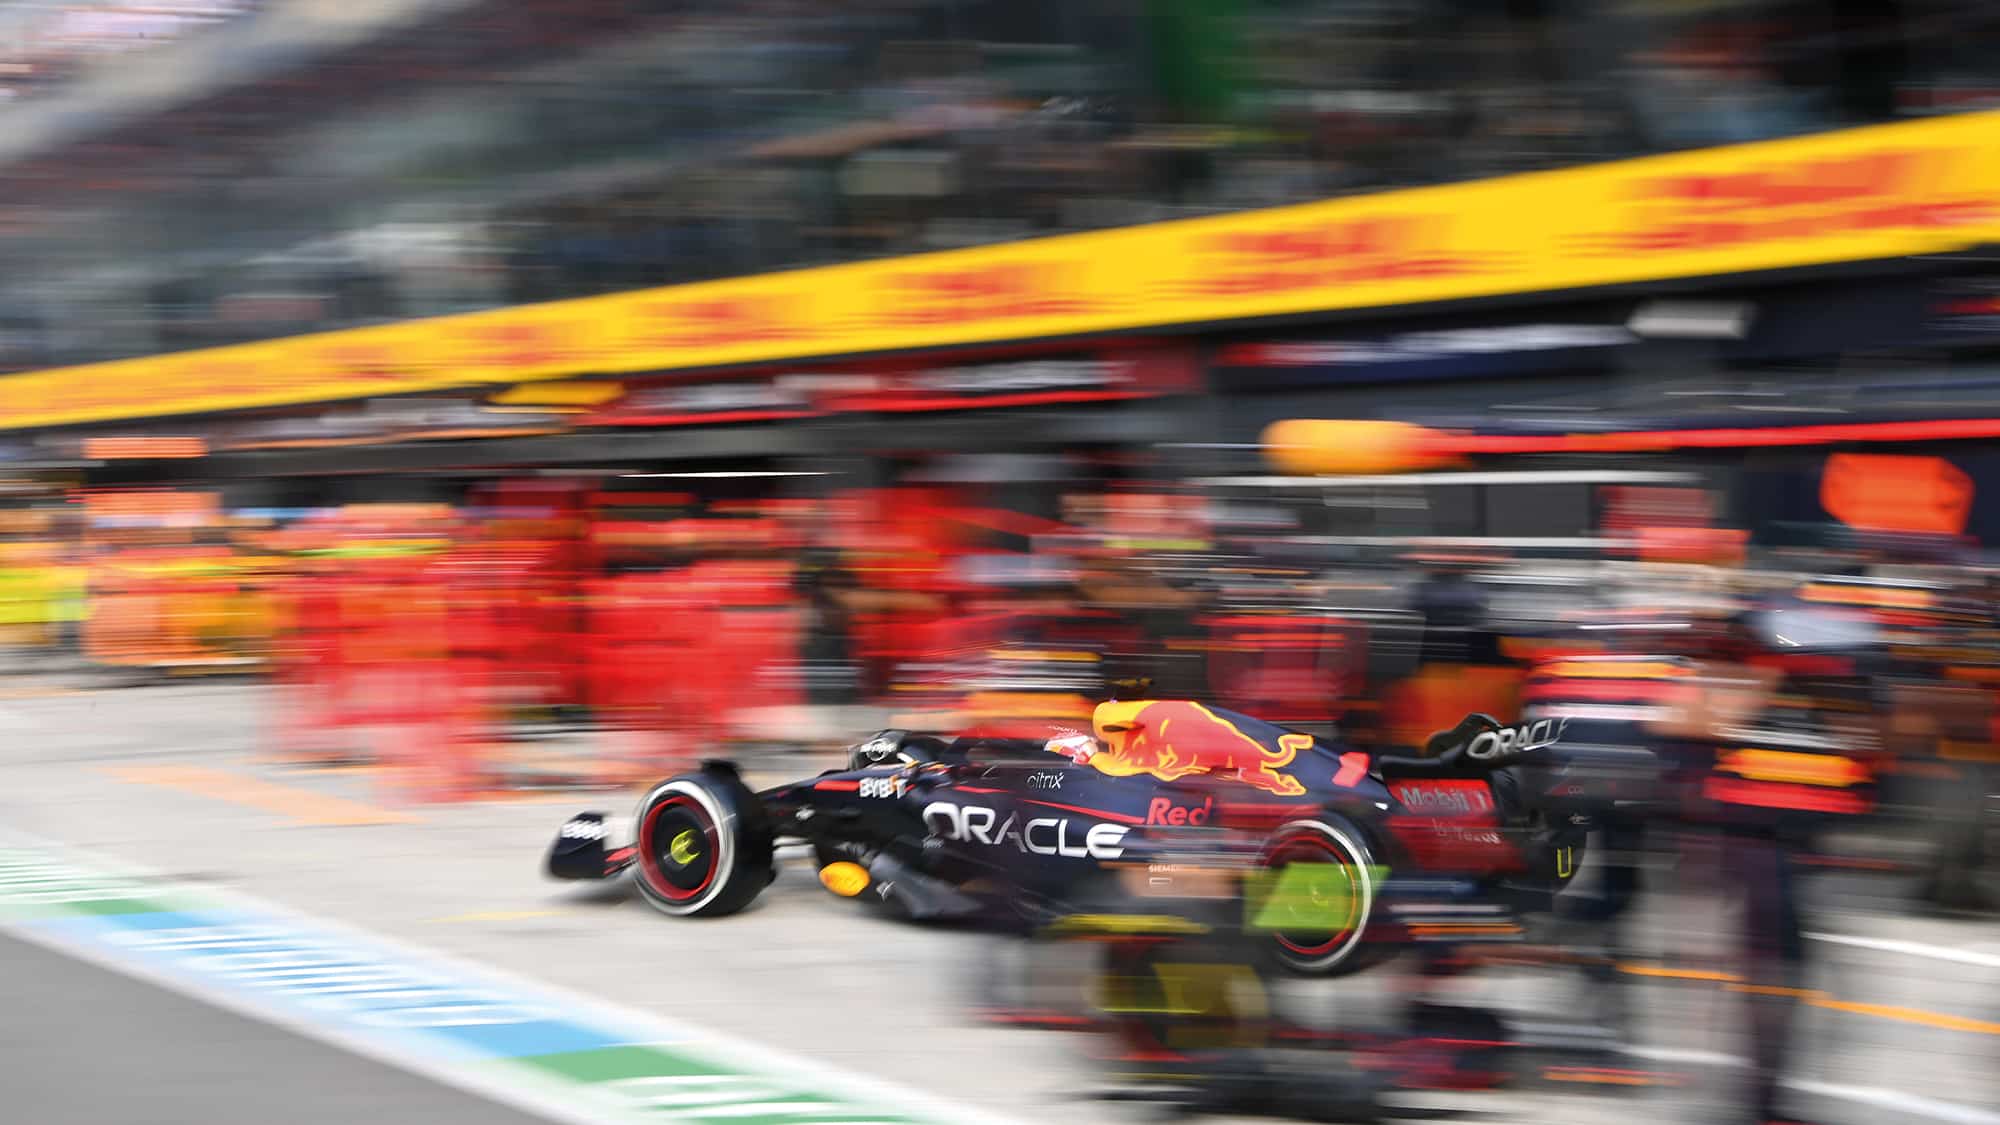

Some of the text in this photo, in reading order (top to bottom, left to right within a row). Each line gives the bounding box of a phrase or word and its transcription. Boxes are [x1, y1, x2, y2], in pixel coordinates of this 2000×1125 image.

[1146, 796, 1213, 826] Red
[1400, 786, 1470, 813] Mobil
[922, 802, 1131, 859] ORACLE
